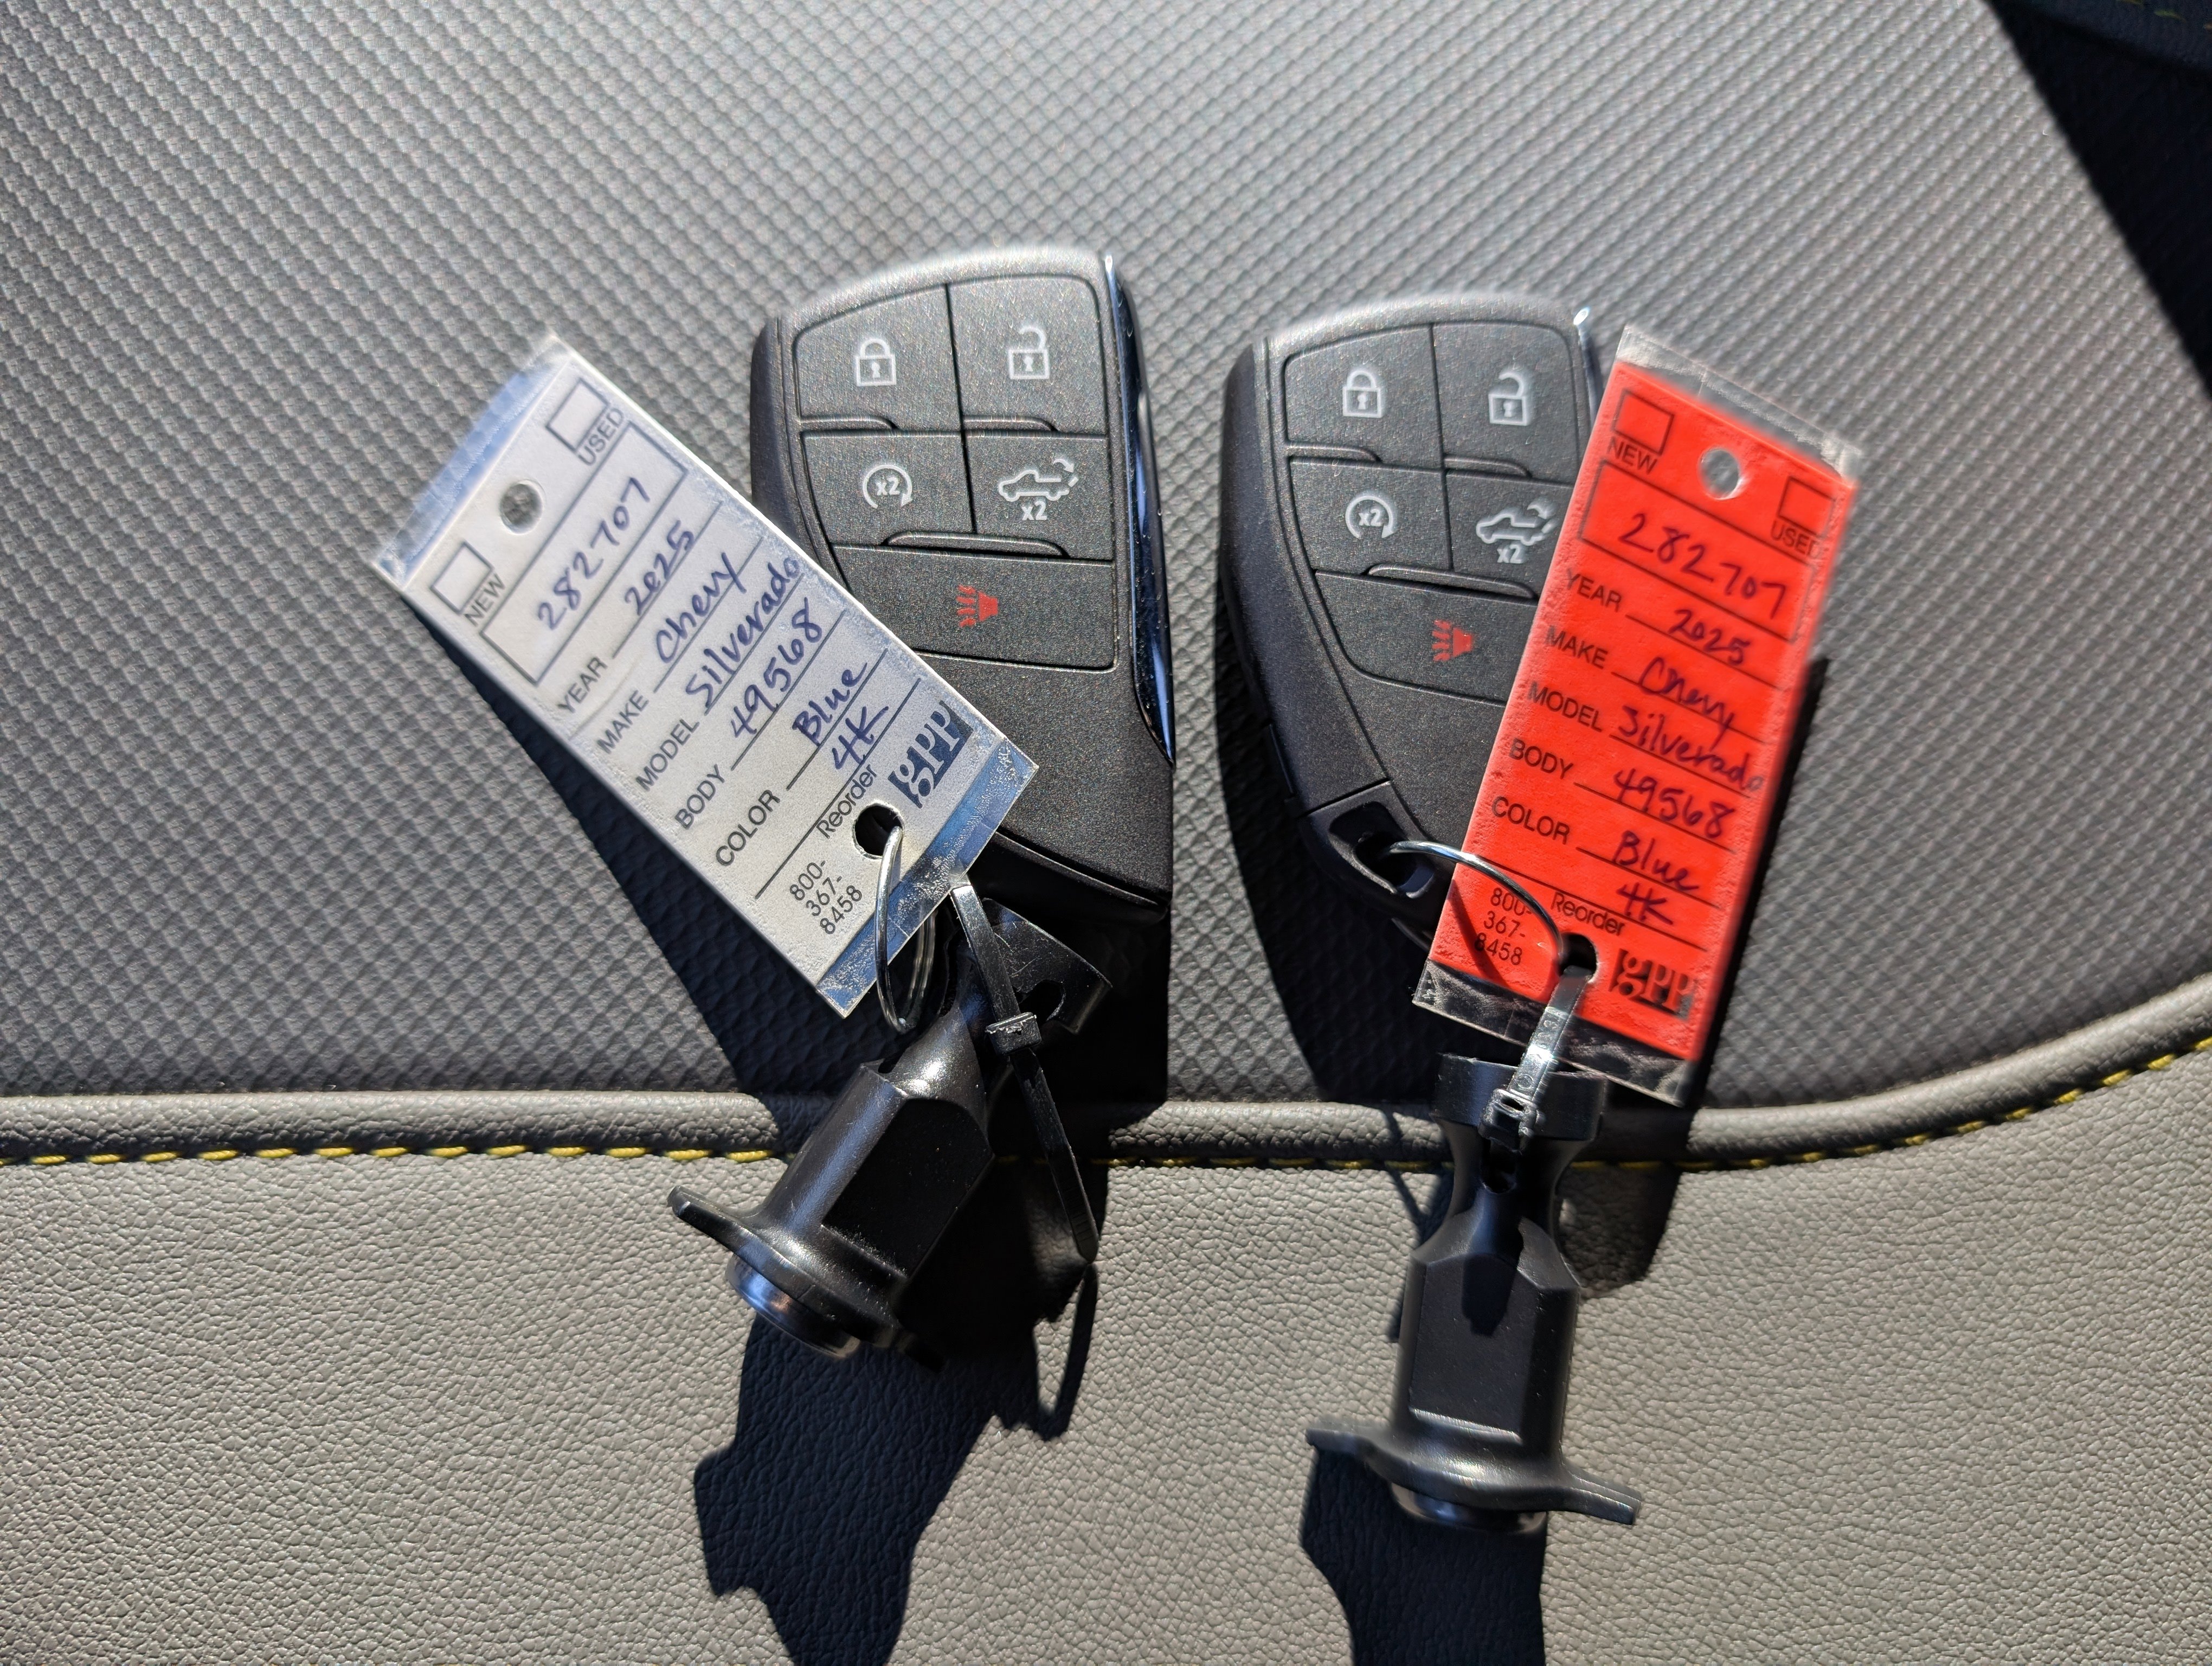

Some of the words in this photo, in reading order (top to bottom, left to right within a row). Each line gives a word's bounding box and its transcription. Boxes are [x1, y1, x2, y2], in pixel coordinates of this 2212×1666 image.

[577, 407, 625, 466] USED
[1607, 437, 1657, 475] NEW
[876, 477, 901, 496] x2
[1021, 501, 1047, 521] x2
[1359, 509, 1383, 527] x2
[1771, 521, 1823, 559] USED
[538, 477, 650, 630] 282707
[1497, 543, 1524, 564] x2
[1618, 513, 1786, 619] 282707
[465, 573, 505, 627] NEW
[656, 552, 747, 663] Chevy
[1566, 569, 1622, 612] YEAR
[685, 557, 800, 708] Silverado
[1546, 626, 1608, 669] MAKE
[1669, 609, 1751, 665] 2025
[558, 657, 607, 713] YEAR
[730, 597, 824, 738] 49568
[597, 690, 649, 754] MAKE
[792, 663, 868, 747] Blue
[1528, 682, 1603, 733] MODEL
[1639, 656, 1734, 752] Chevy
[635, 719, 700, 787] MODEL
[832, 706, 889, 770] 4K
[1509, 738, 1574, 779] BODY
[1618, 706, 1763, 791] Silverado
[677, 764, 726, 829] BODY
[816, 764, 878, 839] Reorder
[1491, 797, 1570, 844] COLOR
[1613, 768, 1735, 838] 49568
[716, 790, 780, 866] COLOR
[789, 861, 826, 901] 800-
[1612, 830, 1698, 891] Blue
[806, 876, 842, 917] 367-
[820, 885, 862, 934] 8458
[1491, 888, 1532, 915] 800-
[1551, 892, 1625, 936] Reorder
[1617, 882, 1673, 924] 4K
[1474, 932, 1522, 965] 8458
[1483, 911, 1525, 937] 367-
